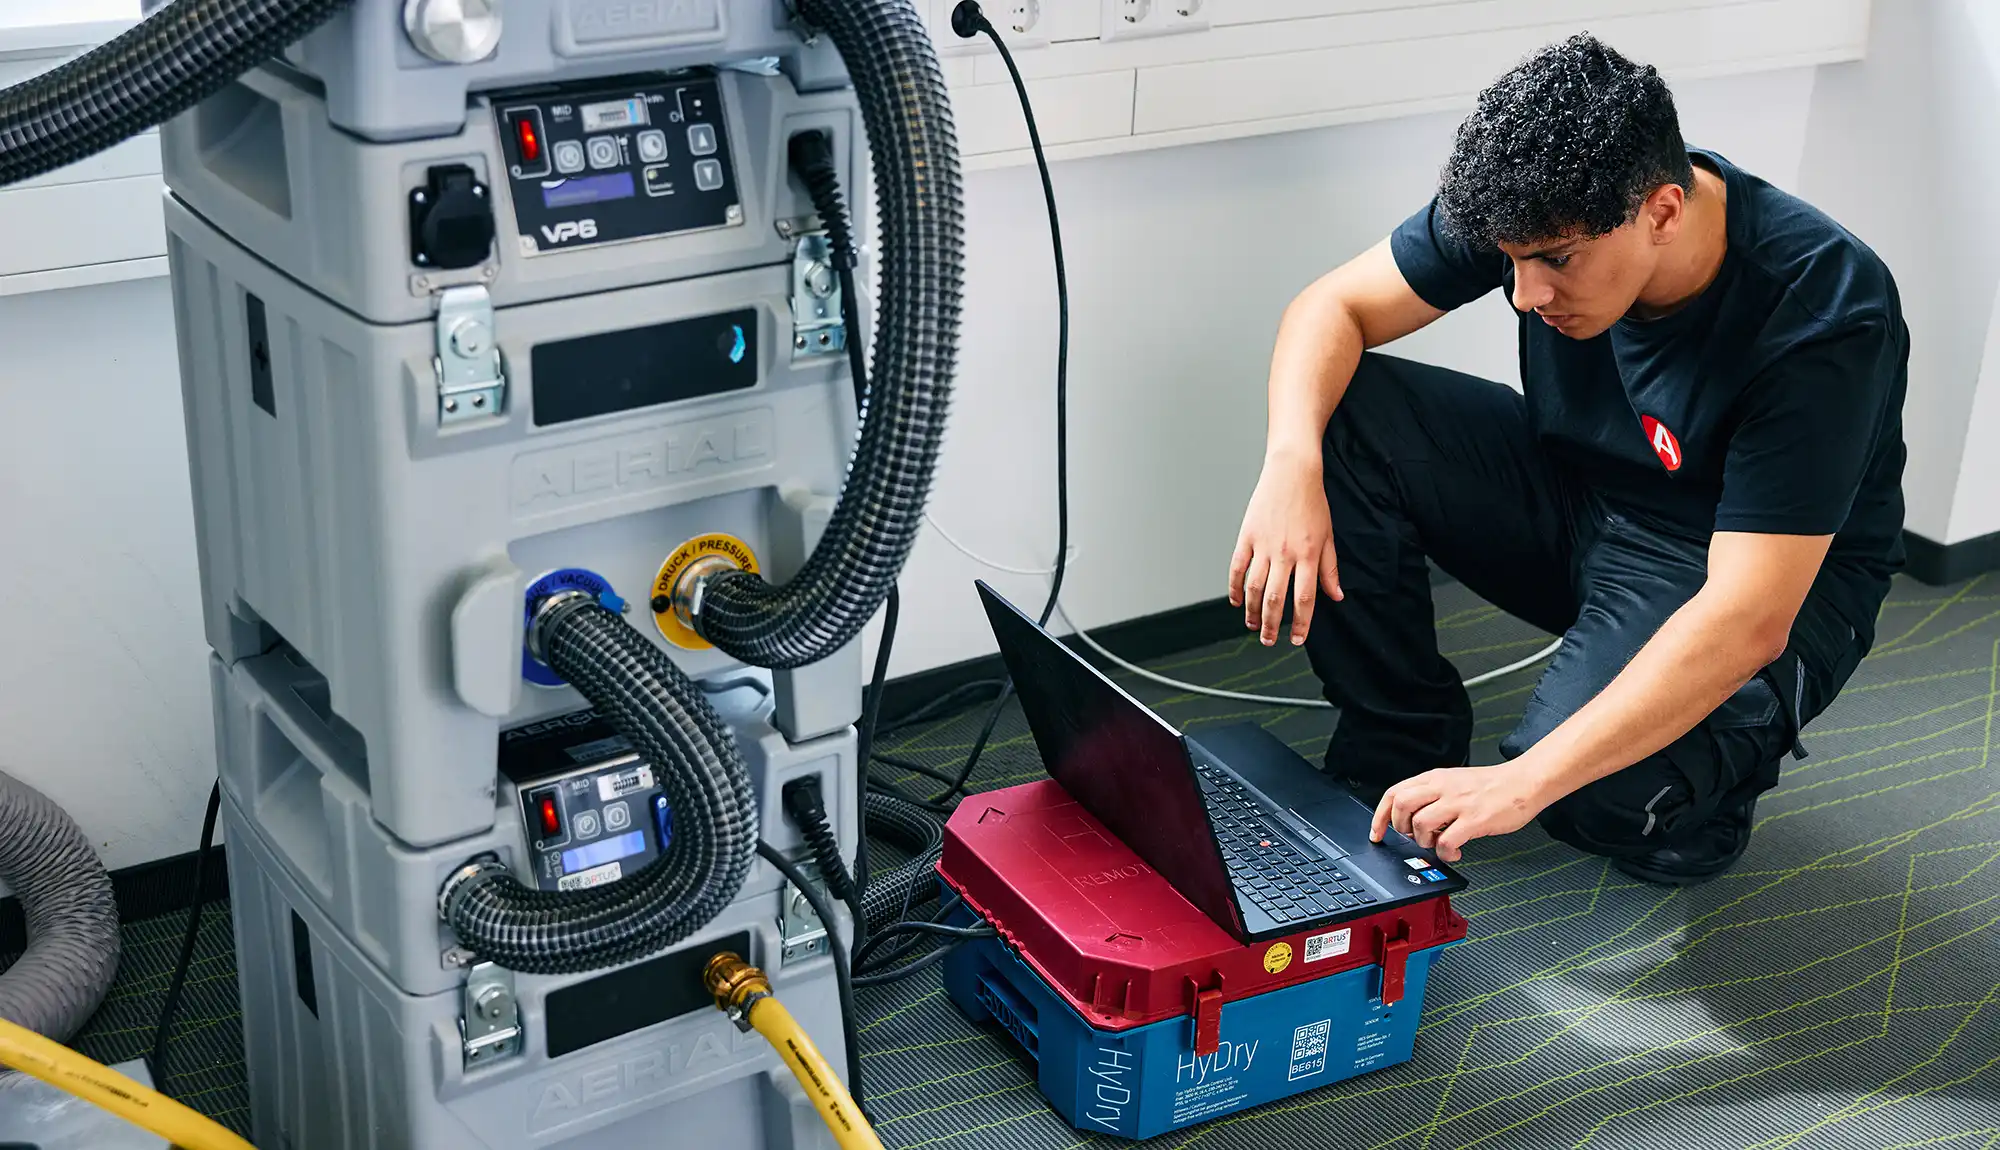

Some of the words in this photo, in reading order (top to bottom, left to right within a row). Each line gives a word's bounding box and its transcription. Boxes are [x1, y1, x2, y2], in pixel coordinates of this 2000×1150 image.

[551, 105, 572, 116] MID
[541, 219, 598, 243] VP6
[517, 422, 768, 506] AERIAL
[658, 548, 690, 591] DRUCK
[699, 539, 753, 572] PRESSURE
[572, 778, 590, 790] MID
[1074, 863, 1151, 888] REMOT
[1176, 1039, 1259, 1085] HyDry
[1291, 1057, 1323, 1074] BE615
[1086, 1047, 1133, 1131] HyDry
